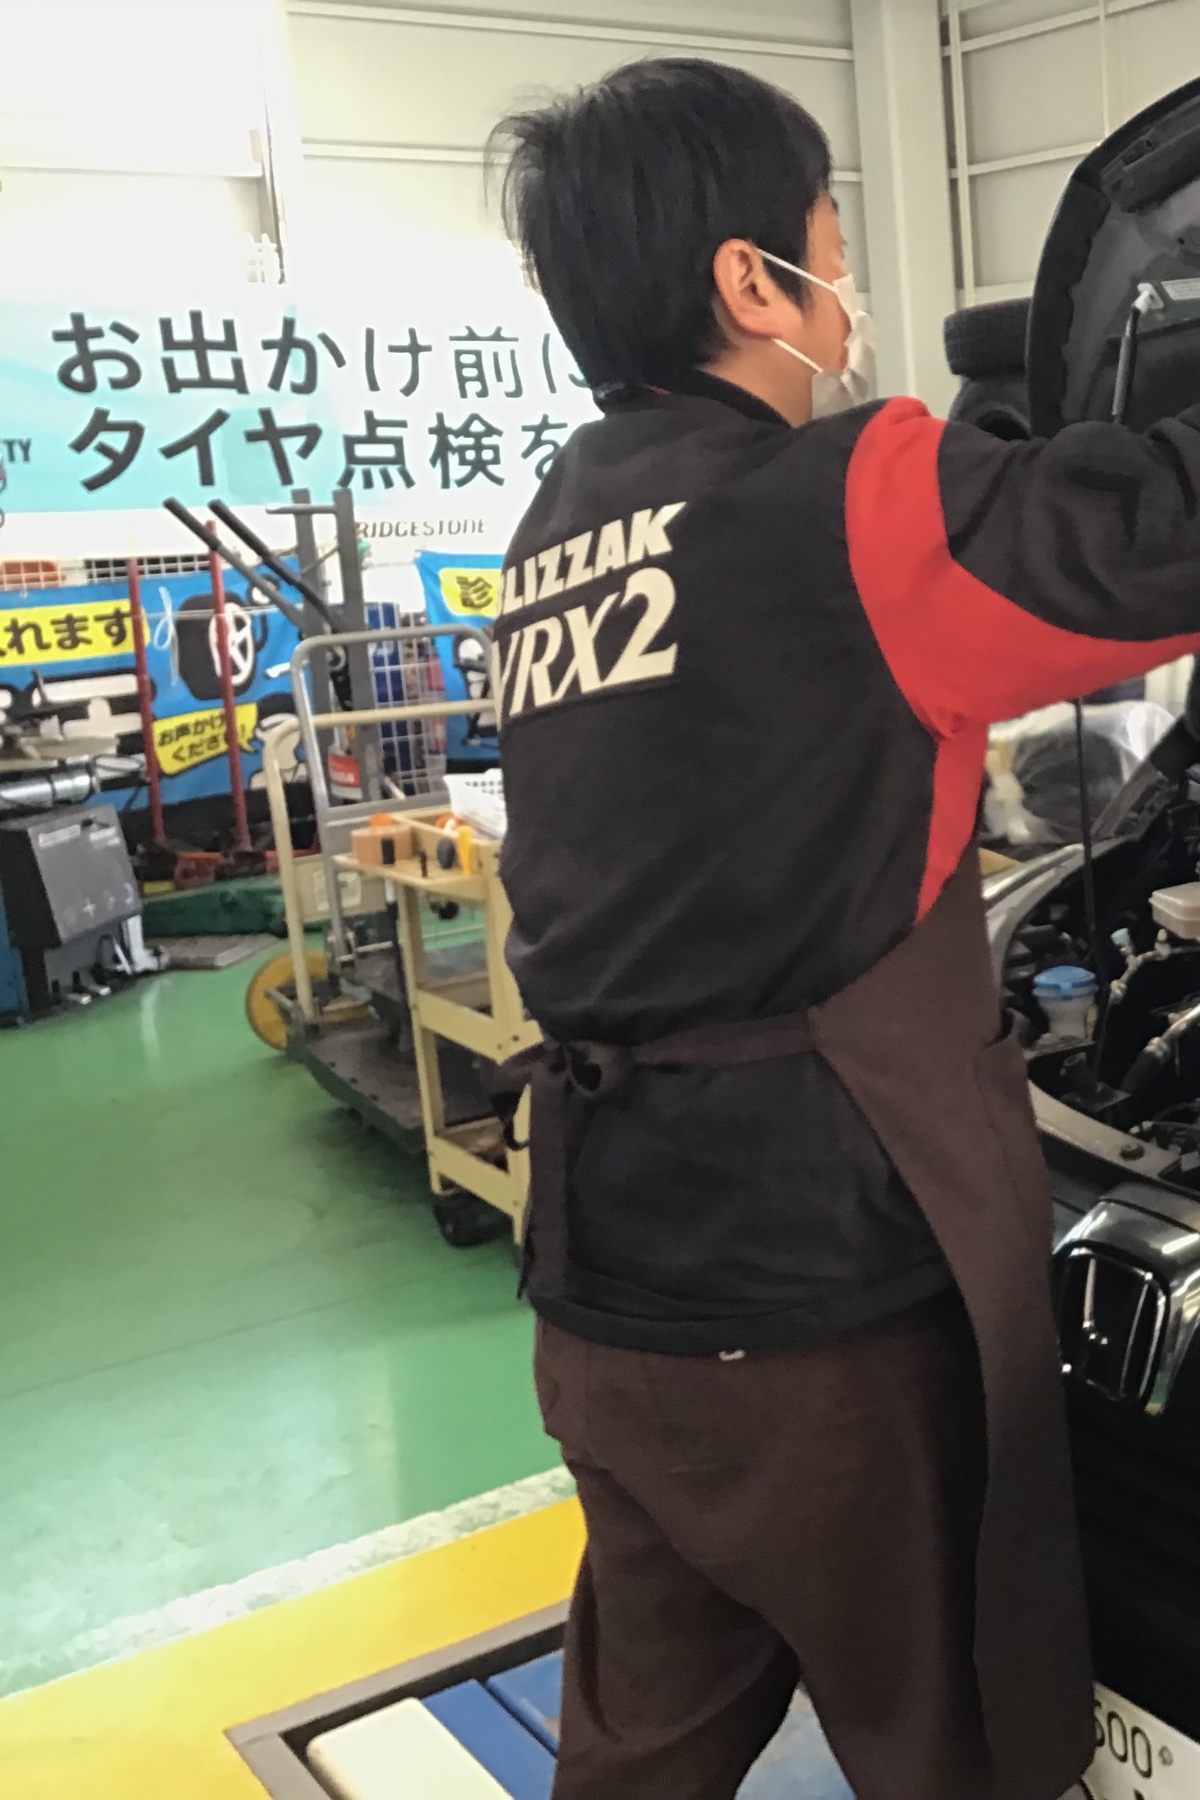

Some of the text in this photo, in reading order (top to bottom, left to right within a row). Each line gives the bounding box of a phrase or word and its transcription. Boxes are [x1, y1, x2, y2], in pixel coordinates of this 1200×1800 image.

[0, 438, 32, 463] TY
[67, 406, 569, 491] タイヤ点検を
[355, 518, 486, 539] RIDGESTONE
[499, 501, 688, 615] LIZZAK
[0, 607, 132, 658] れます
[492, 567, 679, 732] VRX2
